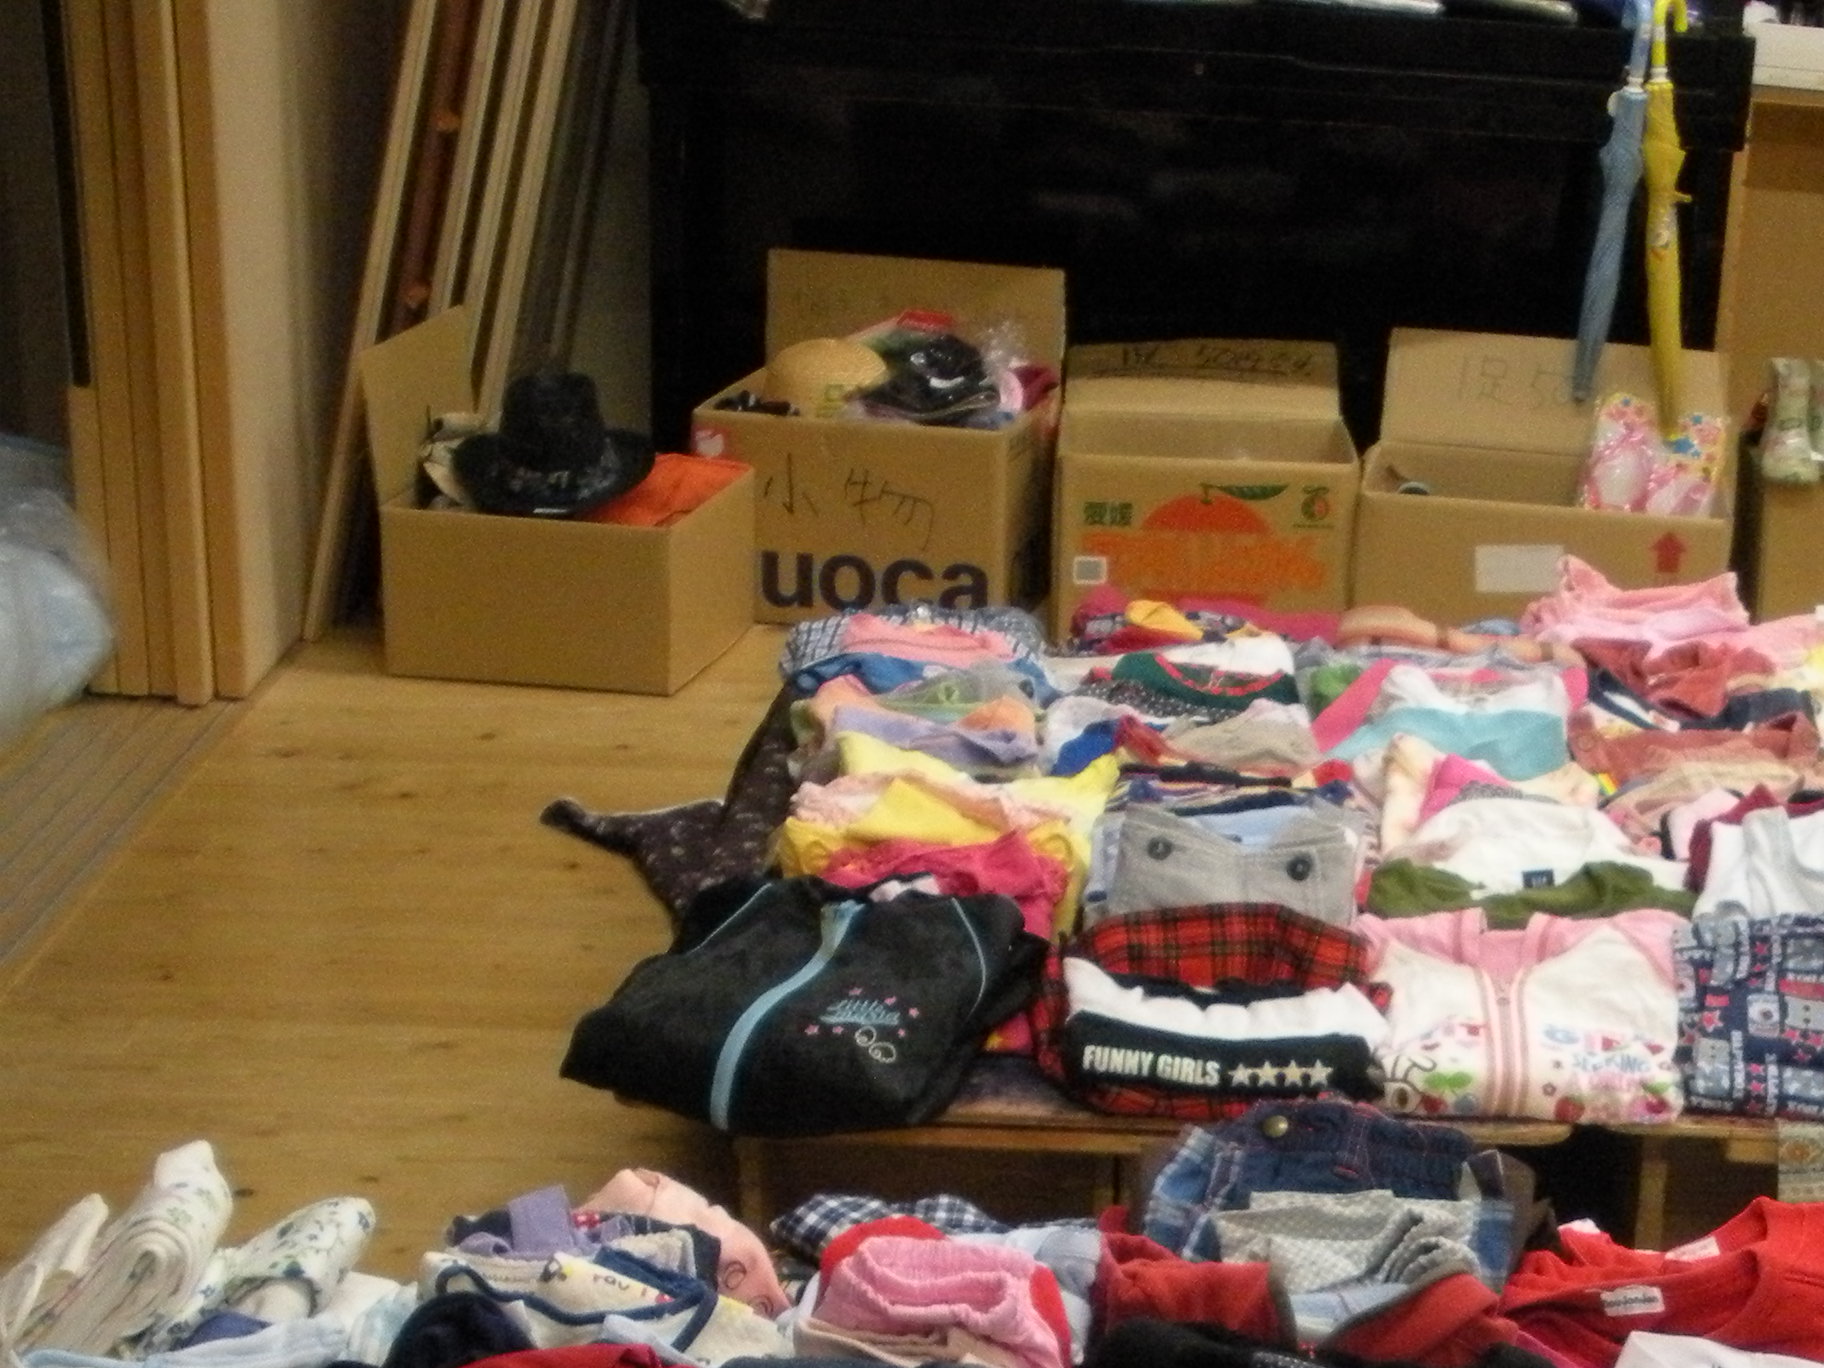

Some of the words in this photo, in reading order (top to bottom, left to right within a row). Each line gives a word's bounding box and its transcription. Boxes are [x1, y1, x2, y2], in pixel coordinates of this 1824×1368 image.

[763, 452, 935, 551] 小物
[1082, 1044, 1154, 1077] FUNNY
[1156, 1054, 1220, 1088] GIRLS
